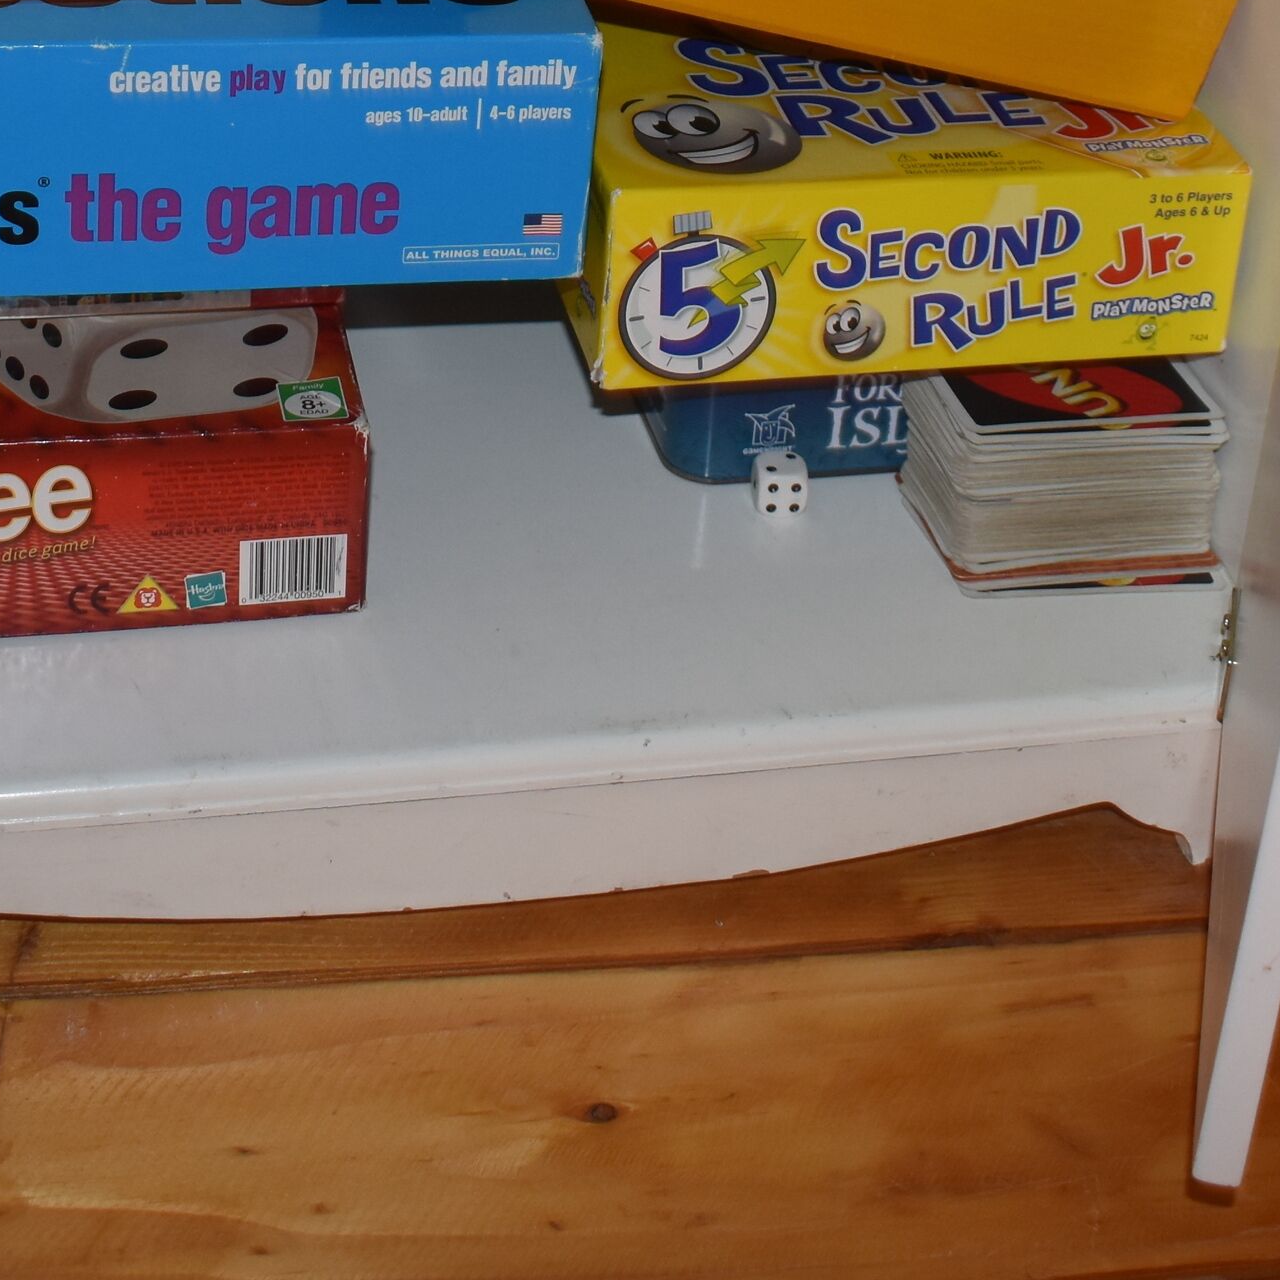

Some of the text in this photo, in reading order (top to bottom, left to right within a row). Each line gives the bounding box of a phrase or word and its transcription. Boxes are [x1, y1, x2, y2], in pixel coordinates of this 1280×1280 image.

[109, 59, 577, 97] creative play for friends and family
[365, 104, 571, 125] ages 10-adult 4-6 players
[776, 93, 1048, 145] RULE
[928, 150, 1004, 160] WARNING:
[1149, 191, 1233, 204] 3 to 6 Players
[64, 173, 182, 242] the
[206, 181, 400, 255] game
[1154, 205, 1231, 220] Ages 6 & Up
[406, 247, 556, 260] ALL THINGS EQUAL, INC.
[658, 239, 742, 358] 5
[814, 208, 1082, 290] SECOND
[909, 224, 1195, 353] RULE Jr.
[302, 400, 326, 410] 8+
[2, 547, 38, 564] dice
[42, 535, 96, 559] game!
[294, 589, 324, 599] 00950
